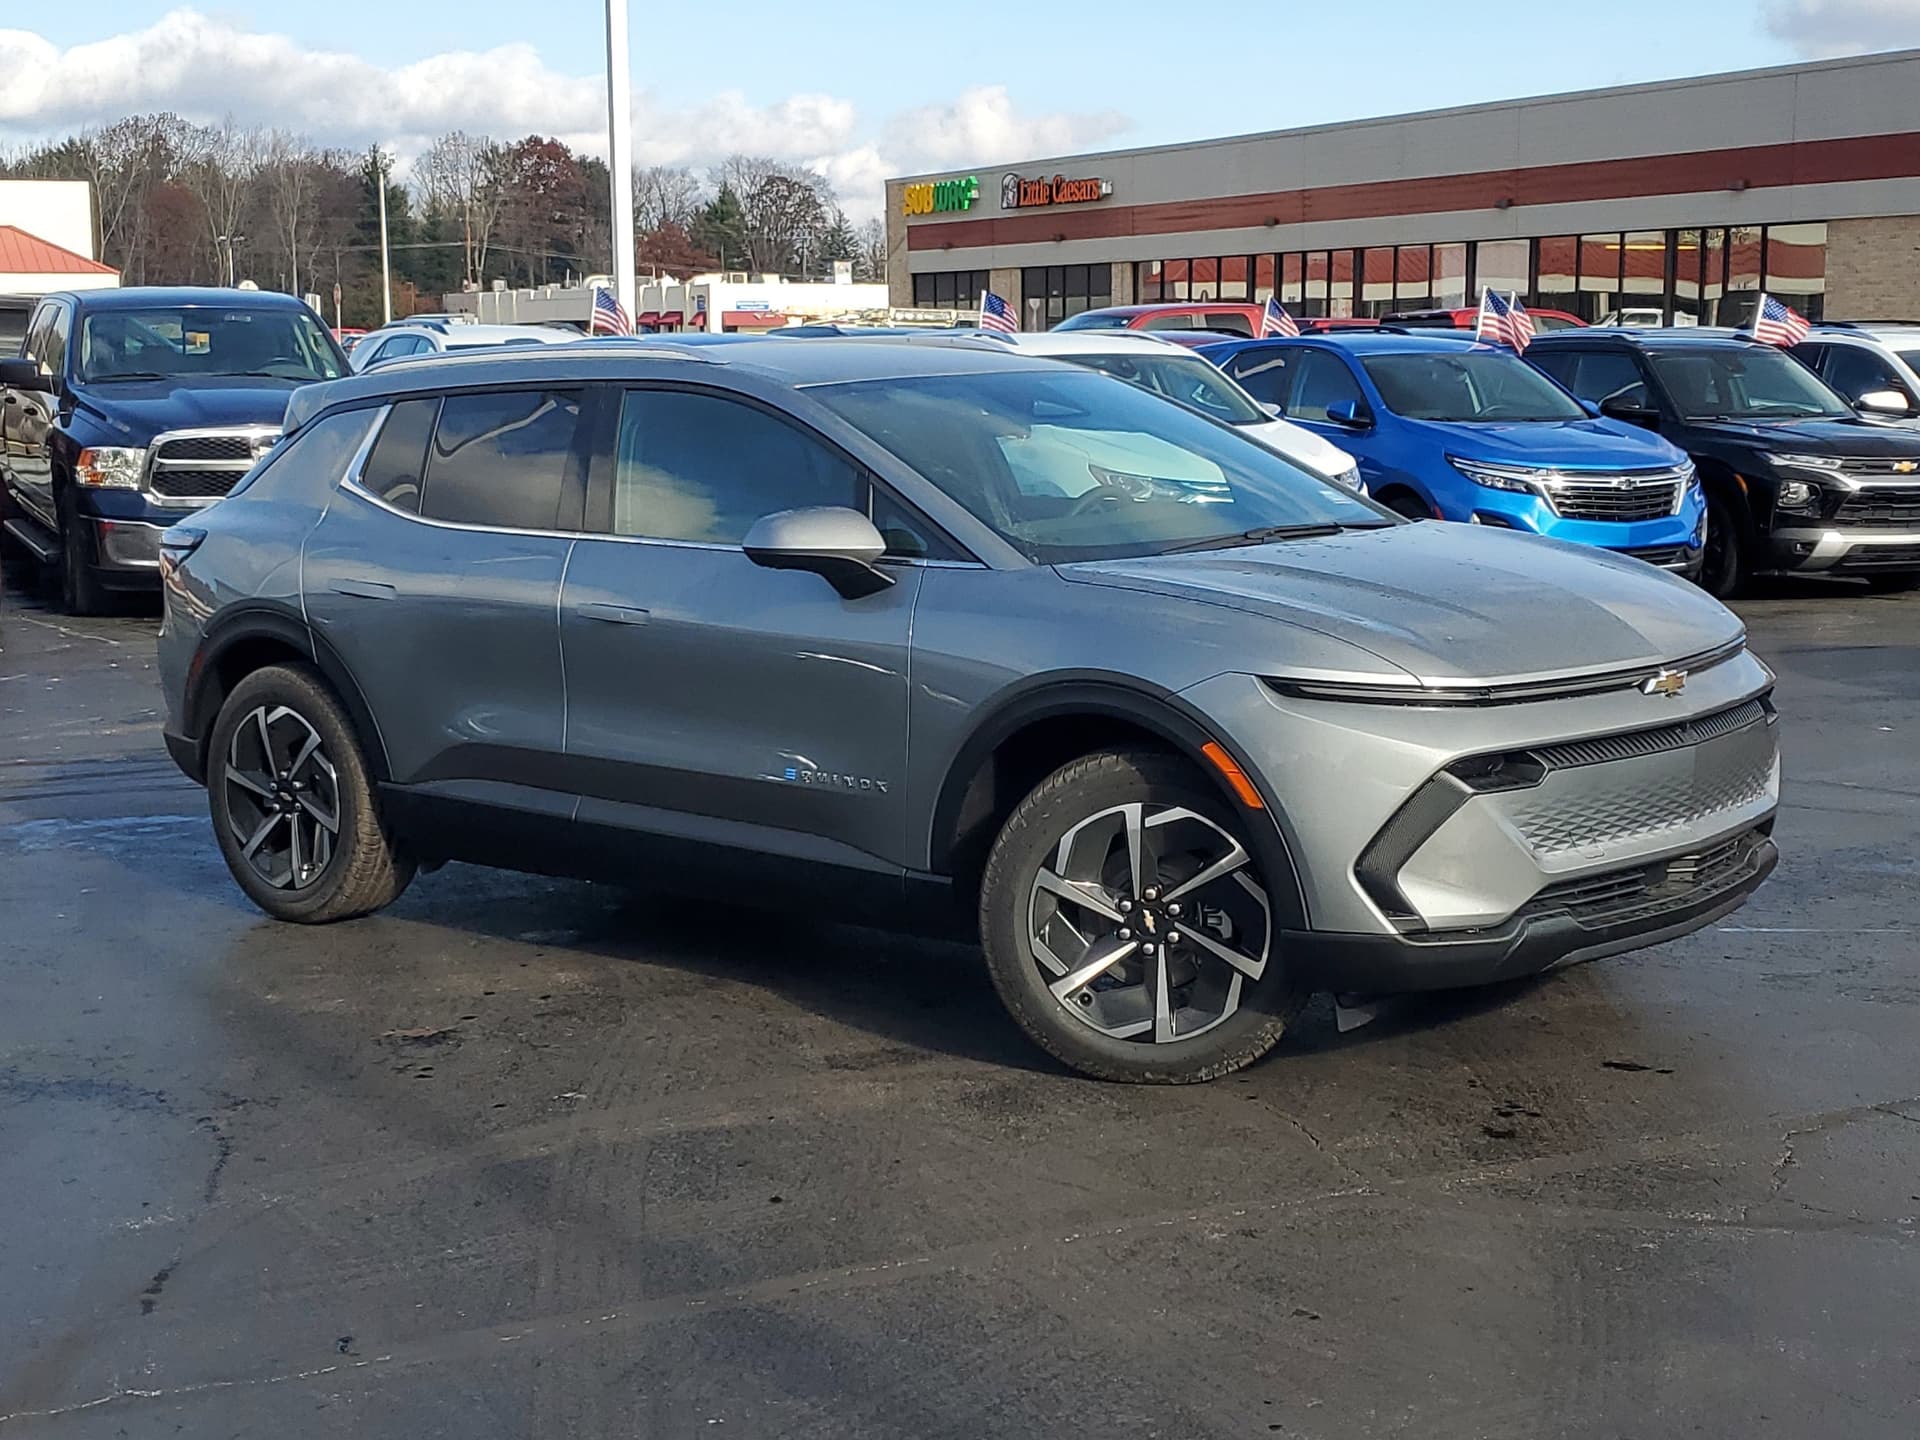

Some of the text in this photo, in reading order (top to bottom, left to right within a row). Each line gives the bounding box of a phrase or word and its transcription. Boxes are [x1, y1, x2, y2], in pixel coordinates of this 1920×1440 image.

[903, 175, 979, 216] SUBWAY
[1019, 174, 1099, 206] Little Caesars
